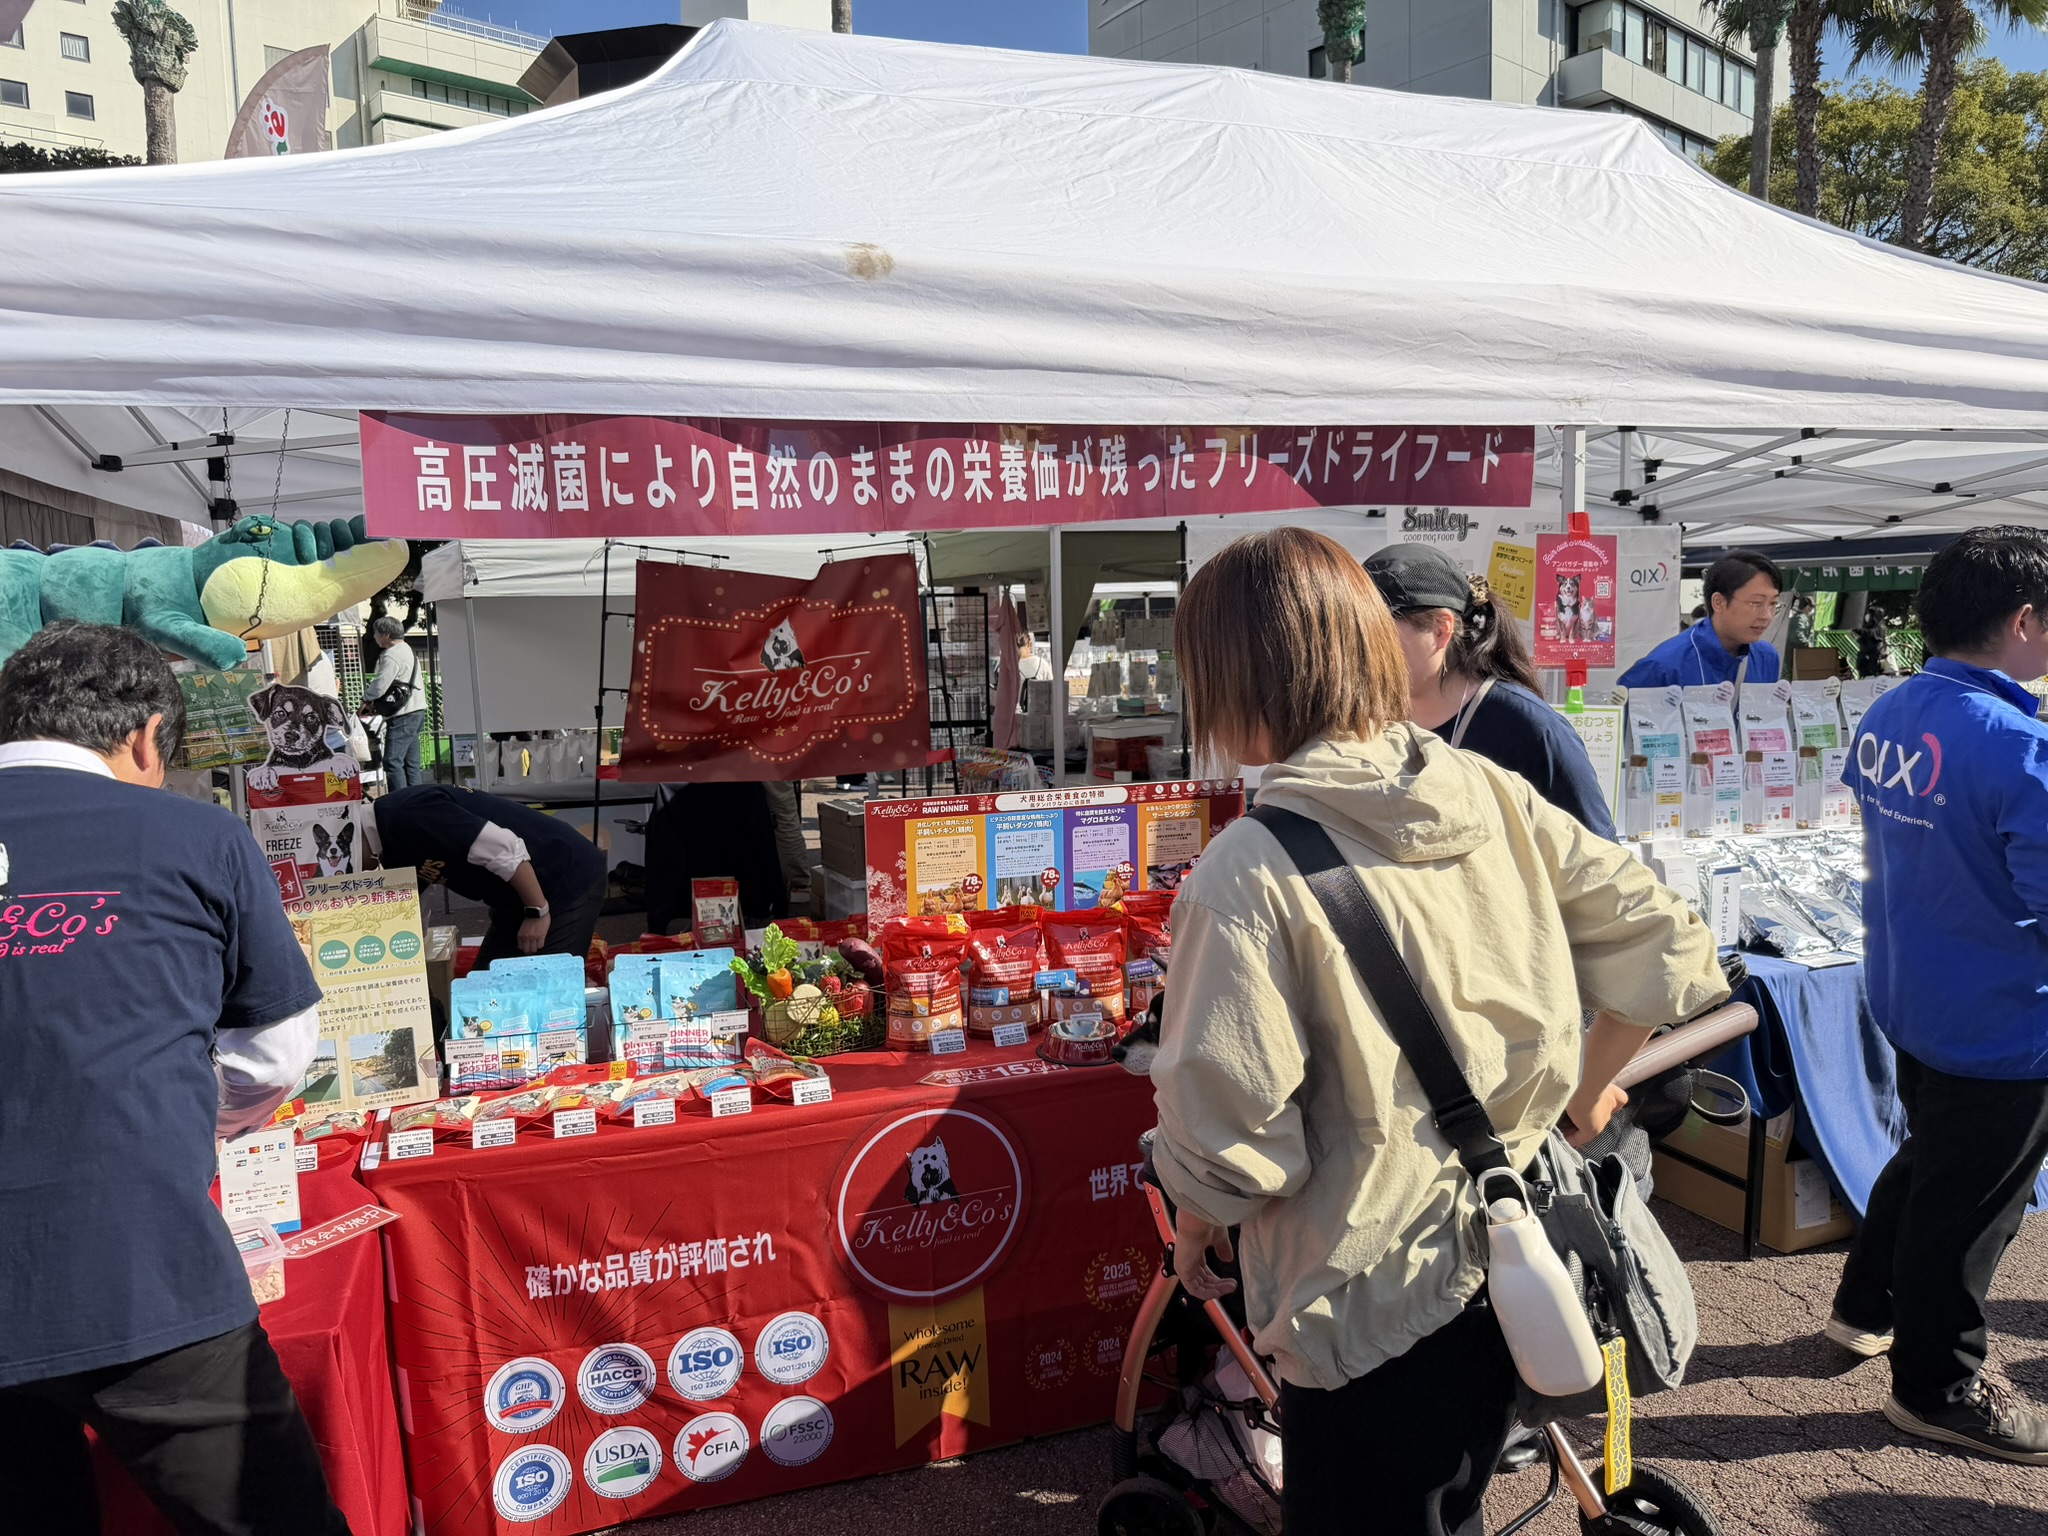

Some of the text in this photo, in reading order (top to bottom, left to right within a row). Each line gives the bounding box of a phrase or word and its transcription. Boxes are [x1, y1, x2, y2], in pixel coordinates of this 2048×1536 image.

[413, 430, 1502, 512] 高圧滅菌により自然のままの栄養価が残ったフリーズドライフード
[1401, 506, 1479, 542] Smiley
[1535, 524, 1553, 532] チキン
[1404, 534, 1454, 543] GOOD DOG FOOD
[1630, 568, 1658, 587] QIX
[689, 658, 872, 719] Kelly&Co's
[802, 702, 811, 714] is
[1857, 732, 1922, 797] QIX
[1020, 790, 1105, 803] 犬用総合栄養食の特徴
[871, 802, 918, 816] Kelly&Co's
[922, 804, 969, 814] RAW DINNER
[1152, 810, 1196, 819] サーモン&ダック
[1080, 816, 1122, 824] マグロ&チキン
[1894, 810, 1934, 830] Experience
[266, 838, 302, 852] FREEZE
[306, 877, 385, 896] フリーズドライ
[283, 888, 413, 915] 100%おやつ新発売
[1721, 876, 1730, 944] ご購入はこちら
[11, 941, 26, 956] is
[391, 942, 418, 950] コンドロイチン
[395, 946, 415, 954] カルシウム
[985, 946, 1027, 961] elly&Co's
[670, 1029, 708, 1038] DINNER
[670, 1037, 708, 1045] BOOSTER
[624, 1047, 662, 1058] BOOSTER
[854, 1192, 1012, 1248] Kelly&Co's
[288, 1209, 381, 1255] 試食会実施中
[525, 1231, 776, 1300] 確かな品質が評価され
[1103, 1261, 1131, 1280] 2025
[773, 1335, 812, 1356] ISO
[1098, 1337, 1120, 1352] 2024
[596, 1354, 636, 1368] FOOD SAFETY
[678, 1346, 734, 1374] ISO
[900, 1344, 982, 1388] RAW
[1040, 1350, 1062, 1366] 2024
[772, 1360, 816, 1374] 14001:2015
[590, 1368, 642, 1386] HACCP
[706, 1378, 727, 1388] 22000
[515, 1382, 532, 1391] GHP
[601, 1384, 635, 1398] CERTIFIED
[920, 1377, 966, 1400] inside!
[520, 1410, 532, 1418] IQS
[790, 1420, 824, 1436] FSSC
[793, 1432, 822, 1444] 22000
[596, 1442, 649, 1464] USDA
[704, 1440, 740, 1456] CFIA
[510, 1454, 552, 1472] CERTIFIED
[516, 1470, 548, 1490] ISO
[515, 1492, 553, 1510] COMPANY
